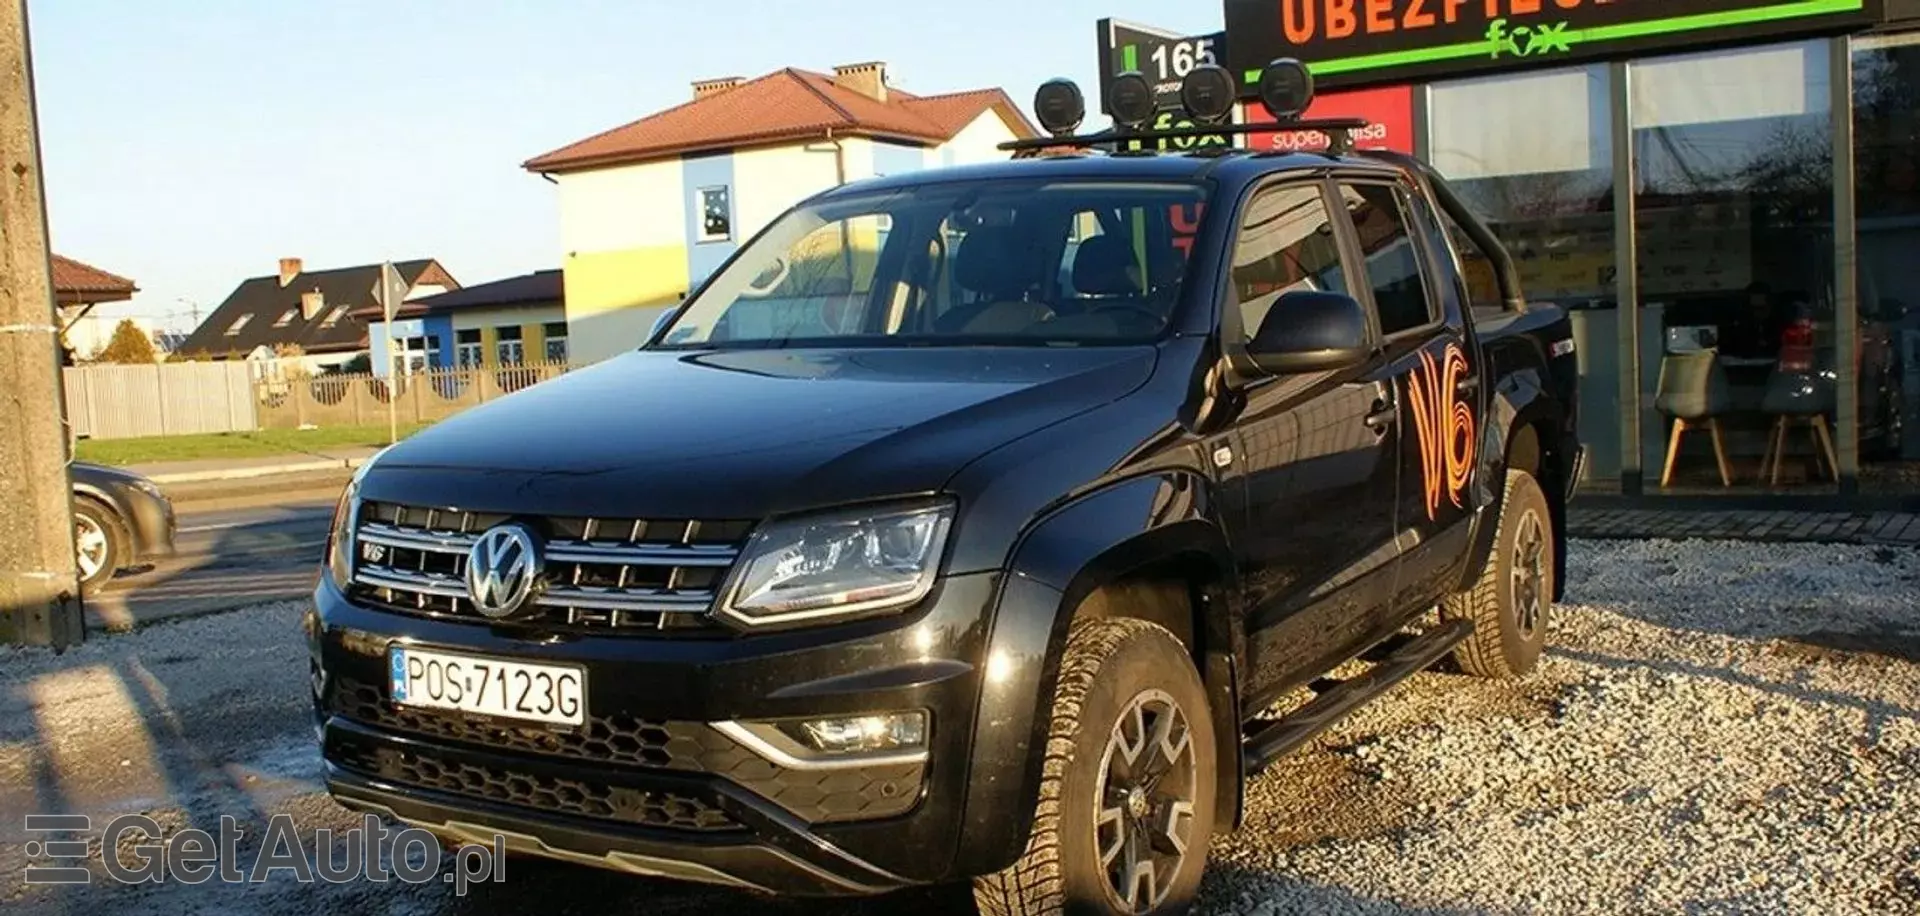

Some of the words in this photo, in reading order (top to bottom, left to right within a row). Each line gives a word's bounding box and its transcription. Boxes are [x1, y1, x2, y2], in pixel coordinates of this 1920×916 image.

[1283, 0, 1617, 44] UBEZP
[1485, 18, 1570, 59] fox
[1151, 38, 1216, 80] 165
[1407, 342, 1475, 520] V6
[363, 543, 385, 562] V6
[408, 656, 463, 704] POS
[473, 665, 579, 718] 7123G
